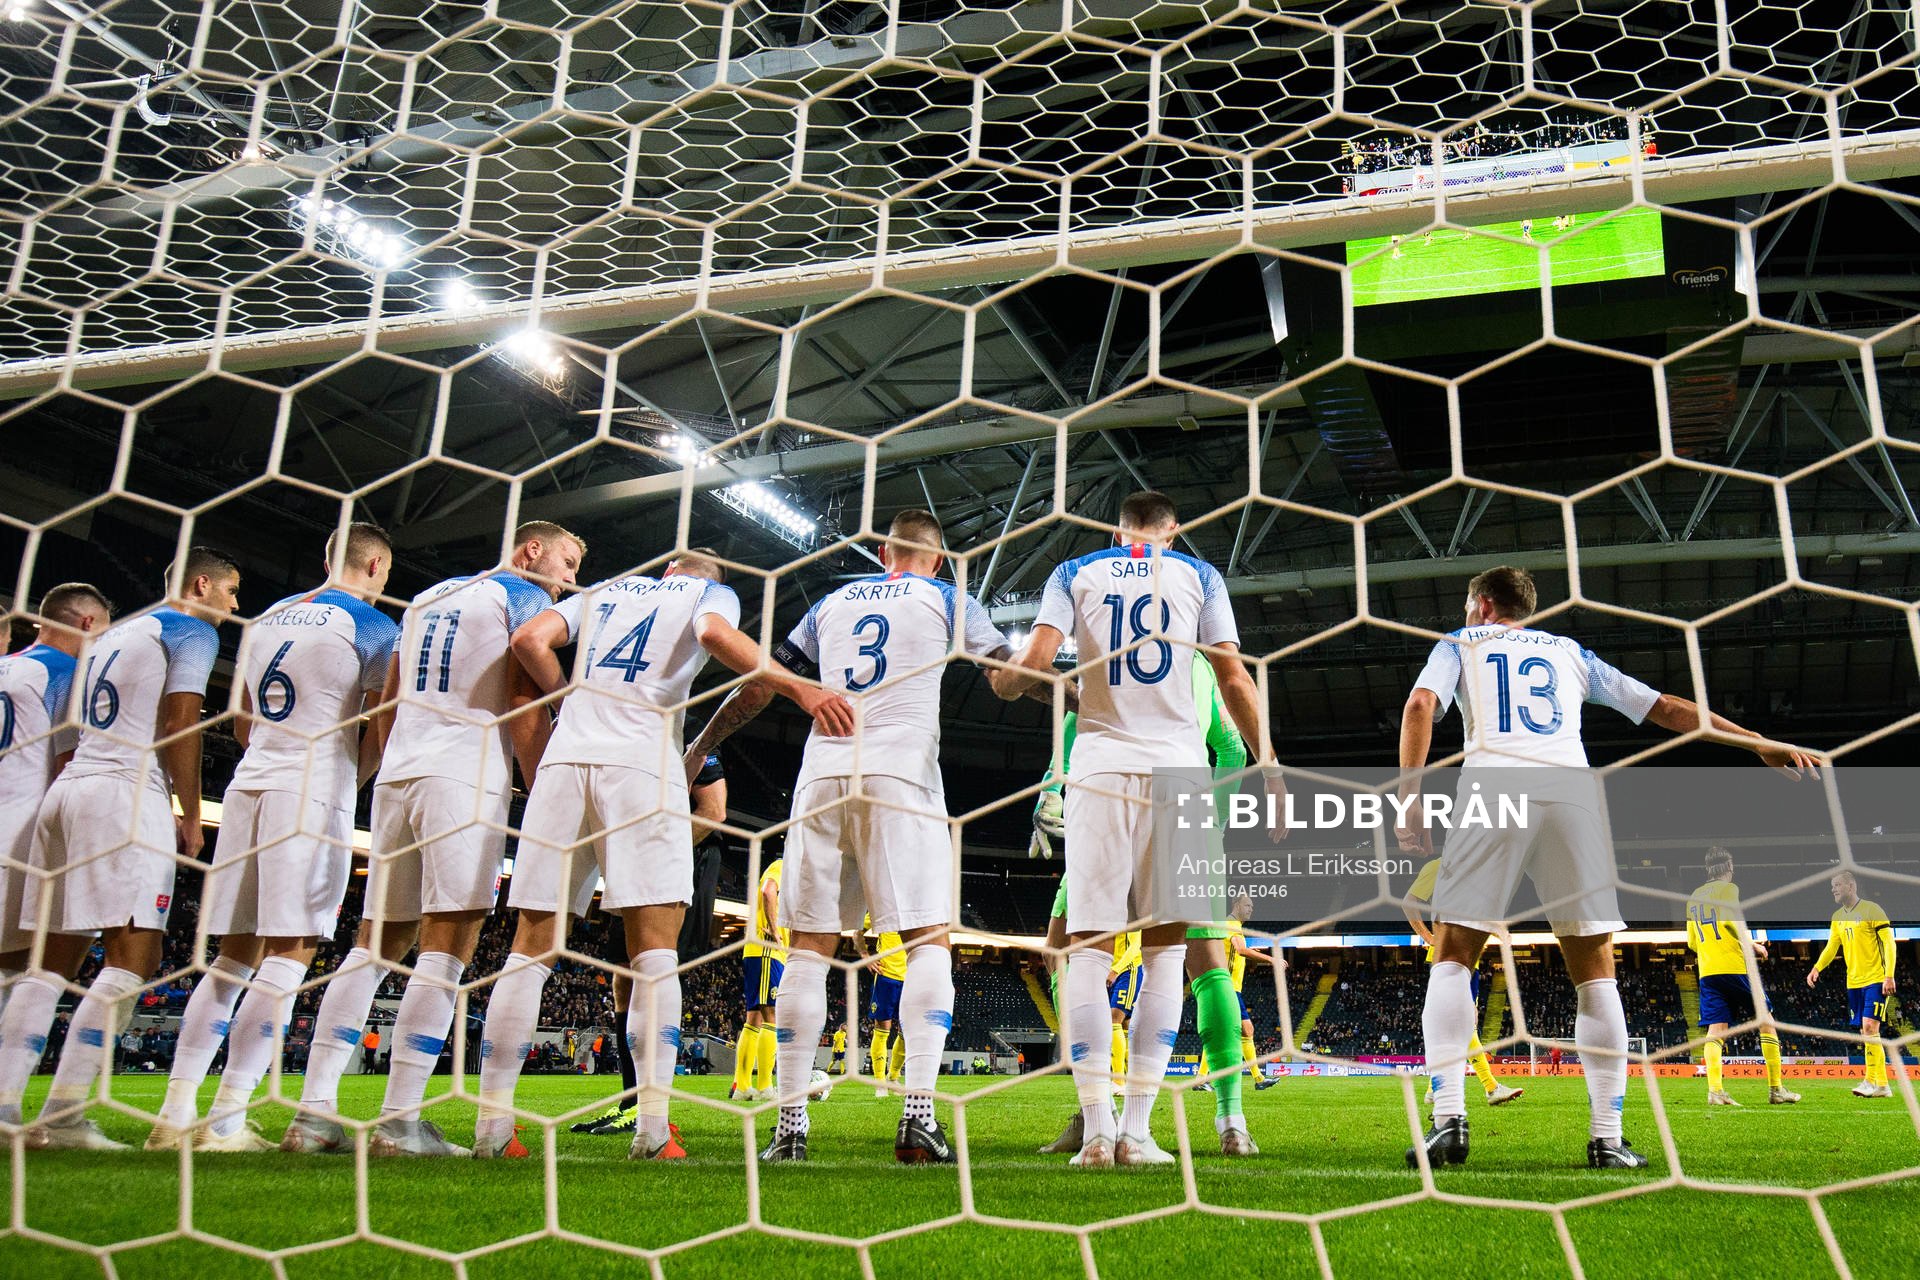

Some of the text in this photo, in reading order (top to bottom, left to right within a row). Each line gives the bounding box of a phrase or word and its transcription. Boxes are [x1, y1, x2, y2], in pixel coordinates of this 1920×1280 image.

[1681, 273, 1720, 285] friends
[259, 606, 335, 627] REGUŠ
[844, 581, 913, 600] ŠKRTEL
[416, 609, 461, 692] 11
[585, 603, 660, 683] 14
[844, 613, 890, 692] 3
[1103, 593, 1172, 685] 18
[80, 649, 120, 734] 16
[258, 640, 296, 722] 6
[1486, 653, 1563, 735] 13
[1690, 903, 1722, 942] 14
[1845, 927, 1854, 941] 11
[1116, 989, 1127, 1005] 5
[1873, 1001, 1885, 1017] 11
